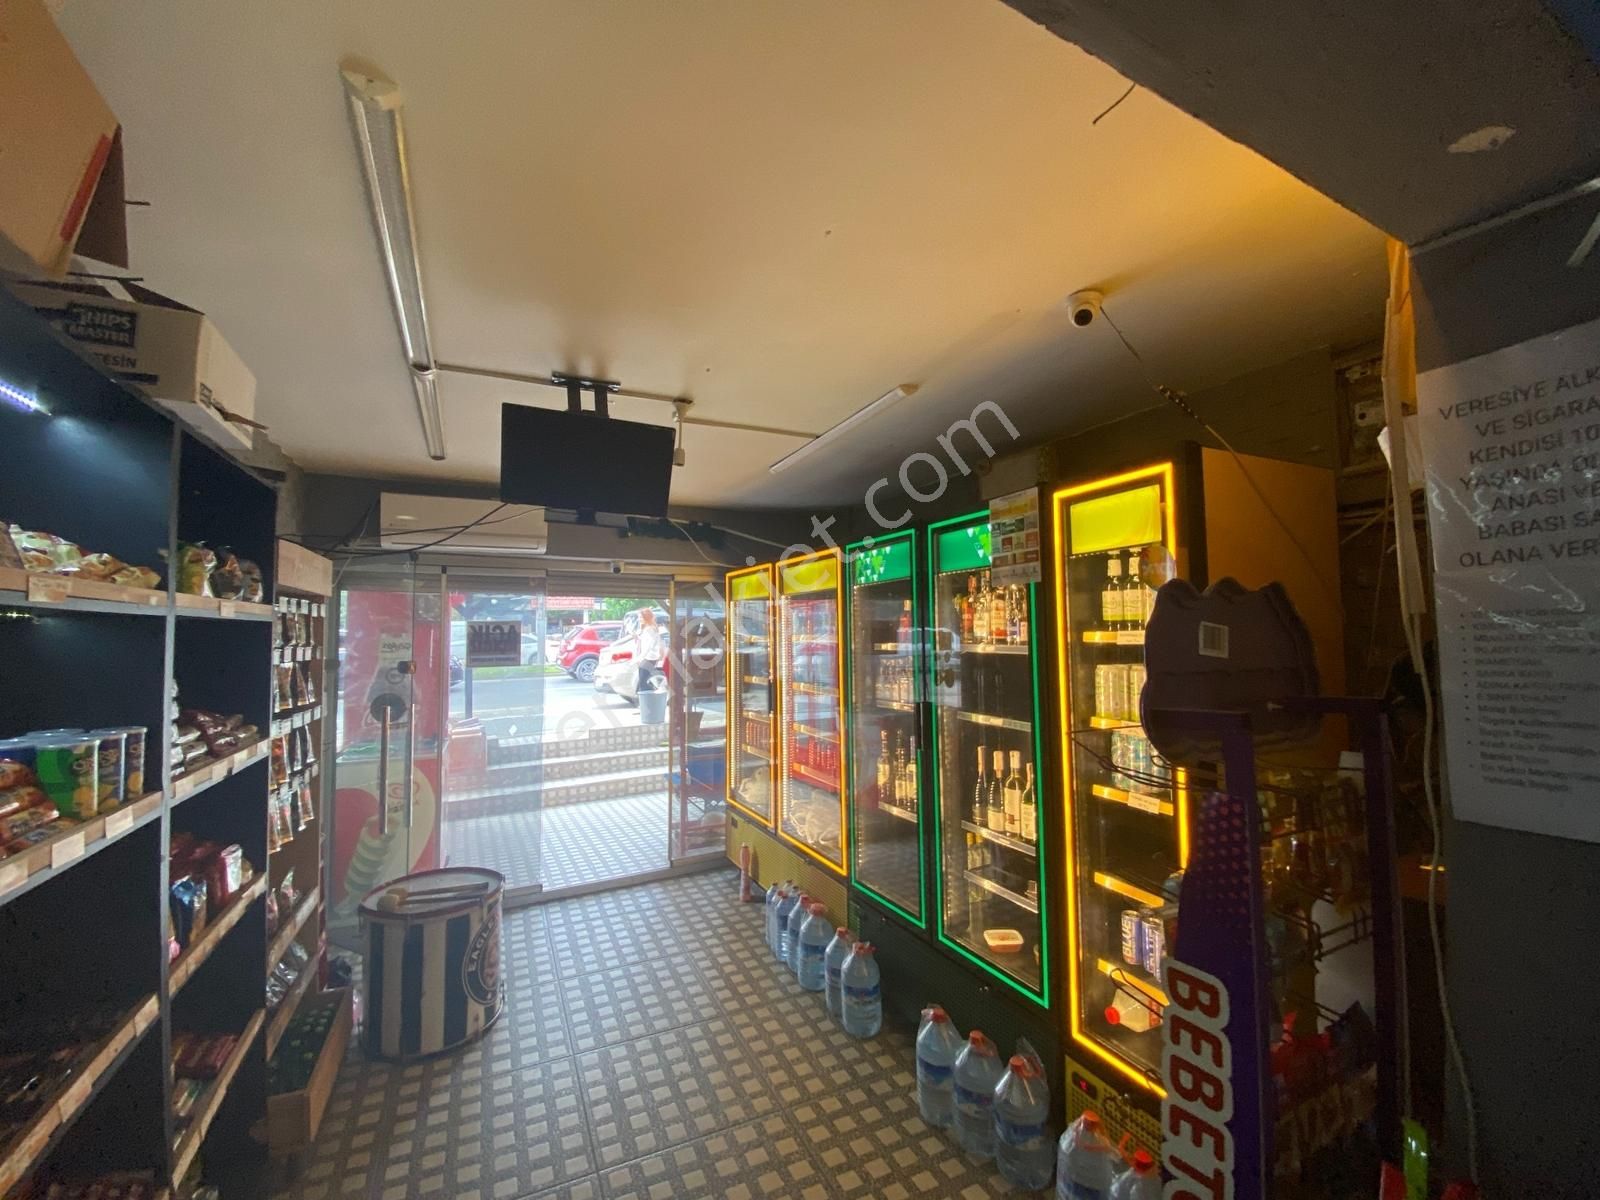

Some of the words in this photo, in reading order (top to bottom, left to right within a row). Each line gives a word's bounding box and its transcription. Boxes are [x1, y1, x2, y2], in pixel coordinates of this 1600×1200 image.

[69, 325, 129, 344] MASTER
[1438, 380, 1547, 421] VERESİYE
[1475, 418, 1506, 437] VE
[1491, 487, 1567, 512] ANASI
[1478, 515, 1568, 540] BABASI
[1459, 546, 1542, 567] OLANA
[1121, 918, 1132, 957] BLUE
